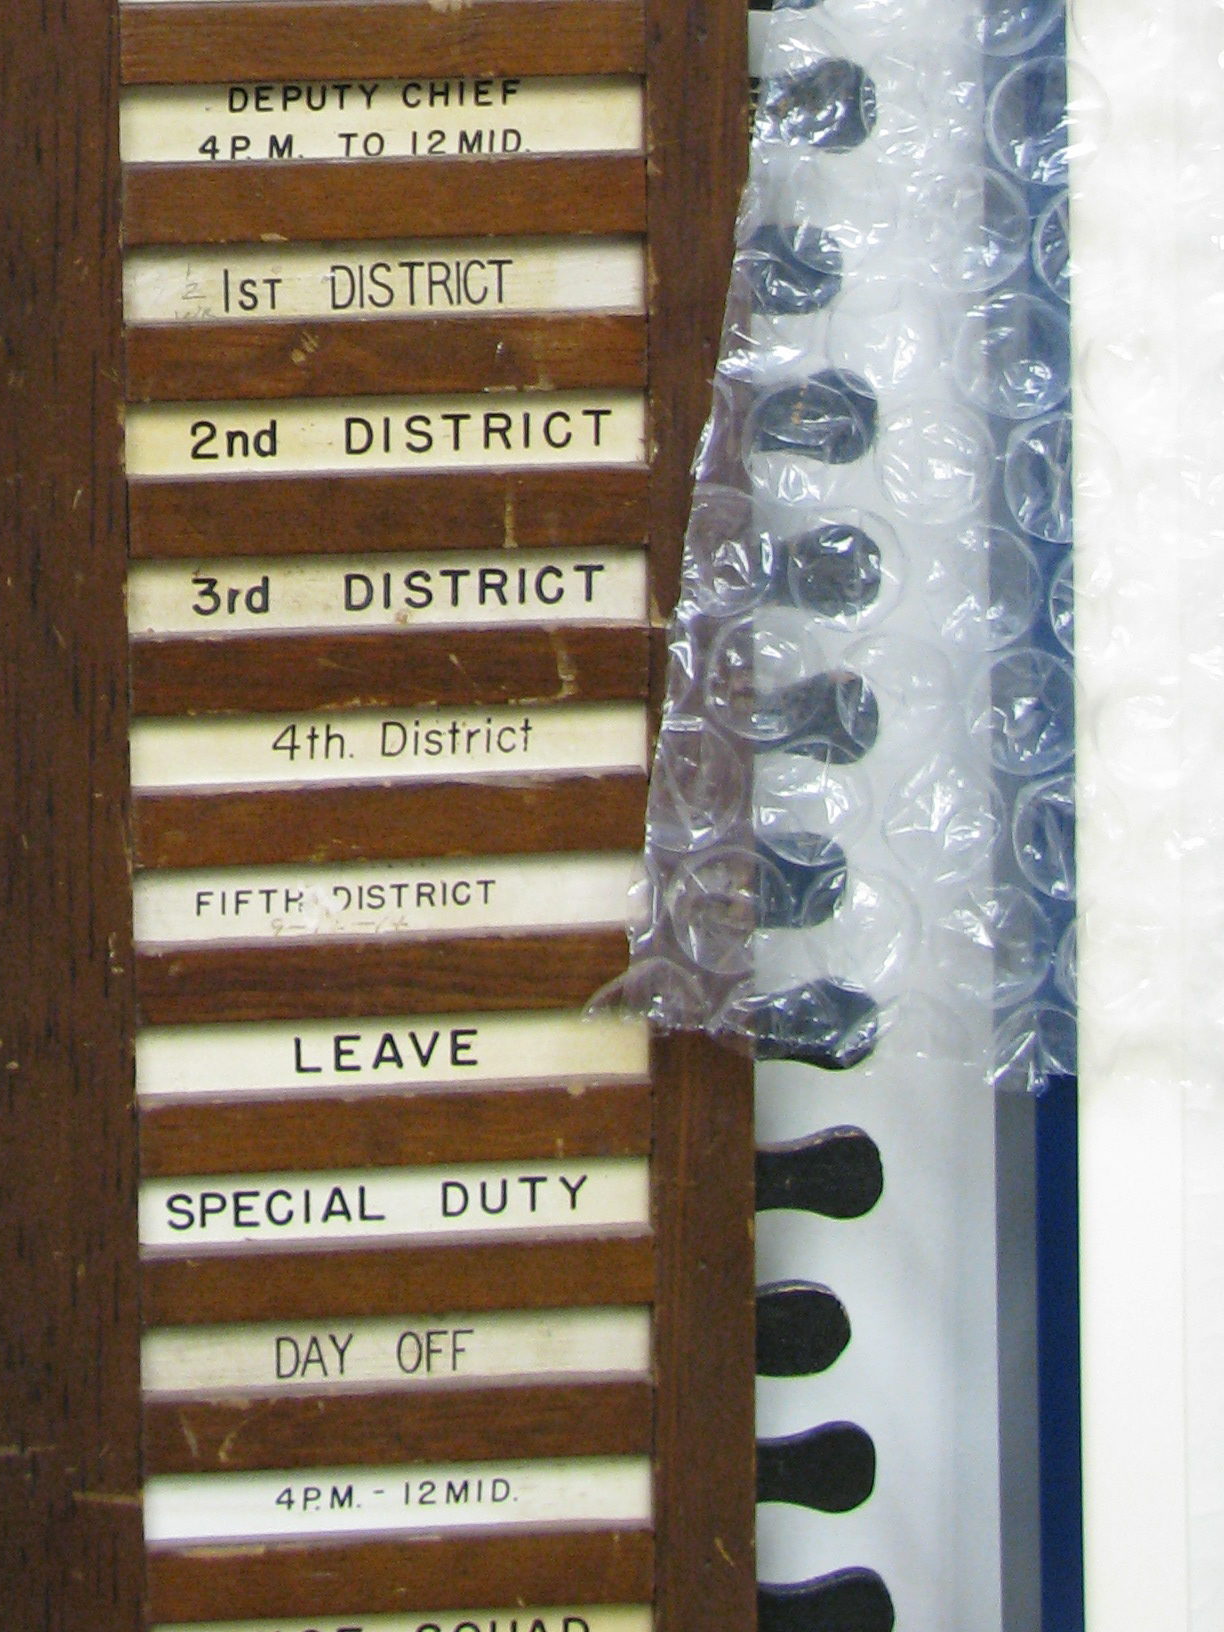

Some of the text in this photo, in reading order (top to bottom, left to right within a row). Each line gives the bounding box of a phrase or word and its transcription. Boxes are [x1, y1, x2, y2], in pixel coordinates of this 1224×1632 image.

[228, 79, 522, 113] DEPUTY CHIEF
[338, 132, 385, 158] TO
[329, 259, 513, 310] DISTRICT
[190, 409, 613, 460] 2nd DISTRICT
[192, 565, 605, 615] 3rd DISTRICT
[271, 718, 534, 761] 4th. District
[196, 889, 305, 917] FIFTH
[294, 1029, 478, 1073] LEAVE
[166, 1175, 589, 1231] SPECIAL DUTY
[275, 1329, 476, 1379] DAY OFF
